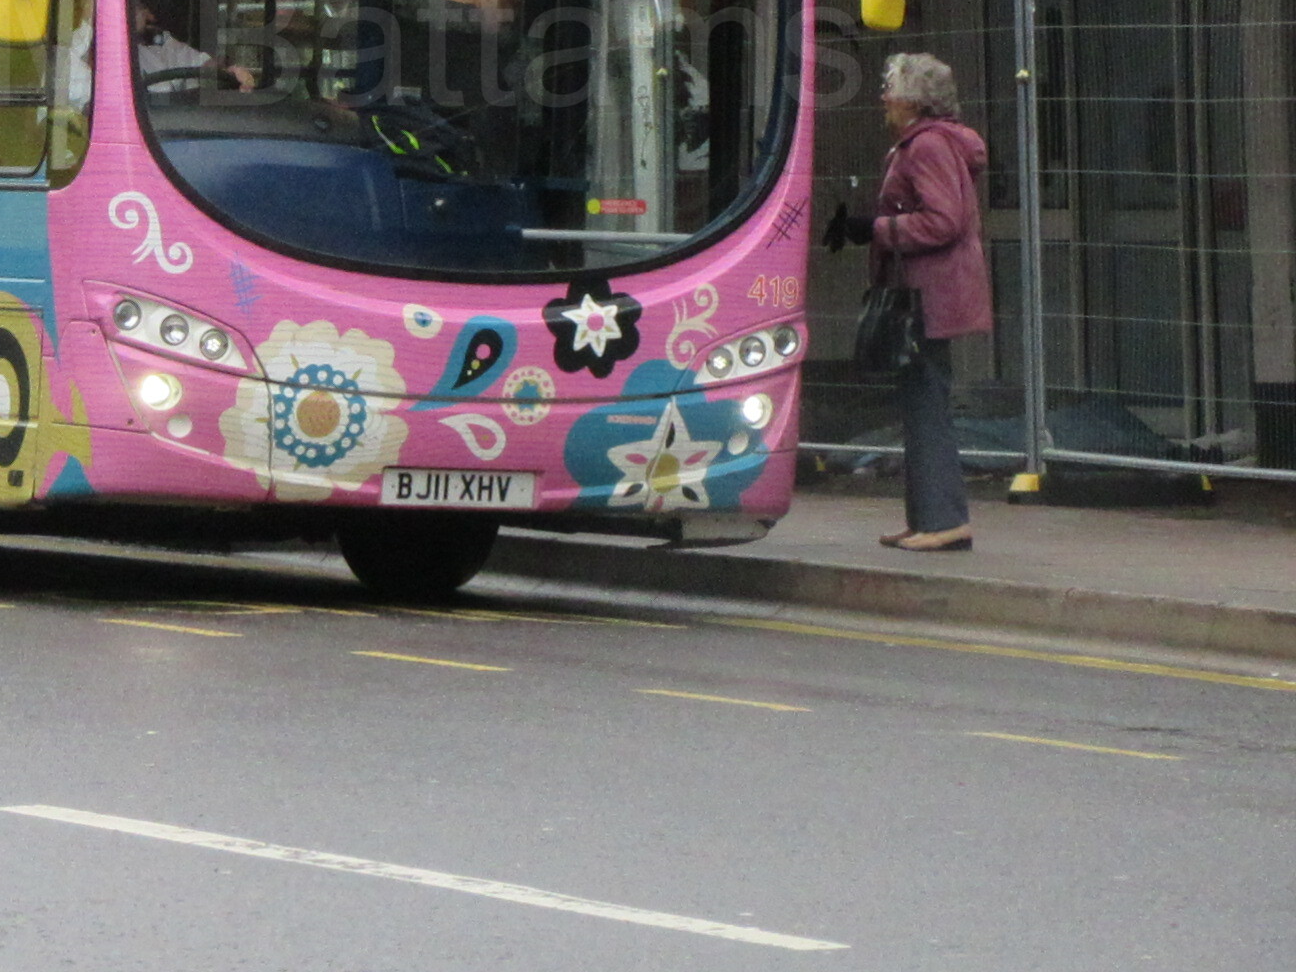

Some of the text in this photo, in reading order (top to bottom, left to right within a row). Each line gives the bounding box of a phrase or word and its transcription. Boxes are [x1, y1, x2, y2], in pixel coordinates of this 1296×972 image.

[746, 274, 800, 309] 419
[396, 472, 512, 503] BJ11 XHV
